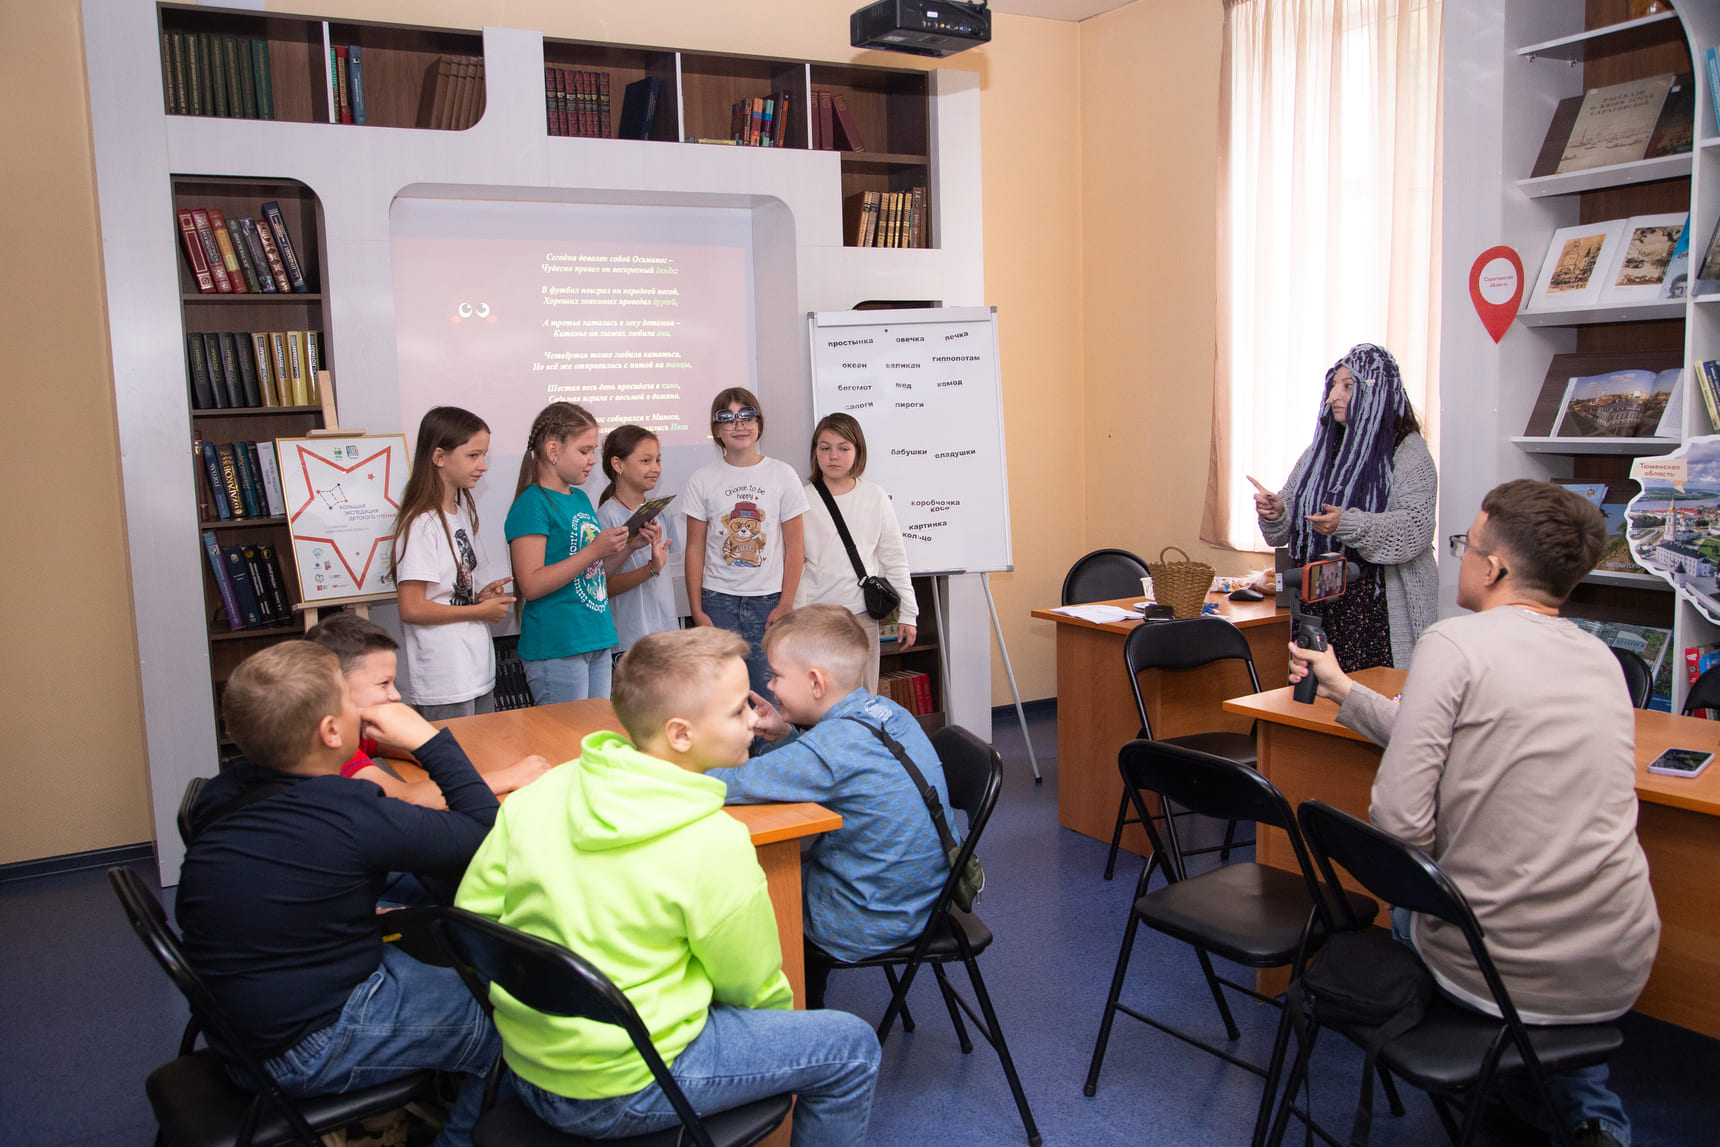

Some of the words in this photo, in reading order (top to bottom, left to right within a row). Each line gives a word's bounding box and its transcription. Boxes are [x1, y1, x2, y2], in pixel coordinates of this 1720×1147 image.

[546, 253, 577, 262] Сегодня
[578, 254, 608, 263] доволен
[609, 255, 631, 263] собой
[632, 256, 668, 265] Осьминог
[542, 264, 573, 273] Чудесно
[612, 266, 654, 275] воскресный
[541, 286, 548, 294] В
[548, 286, 579, 296] футбол
[581, 287, 611, 296] поиграл
[623, 288, 656, 297] передней
[657, 288, 680, 297] ногой,
[543, 297, 579, 306] Хороших
[618, 298, 651, 307] проведал
[542, 319, 549, 327] А
[550, 320, 581, 328] третья
[582, 320, 618, 328] каталась
[624, 320, 641, 329] лесу
[552, 329, 588, 338] Катанье
[599, 330, 626, 338] лыжах
[627, 329, 655, 337] любила
[828, 337, 874, 348] простынка
[895, 336, 925, 344] овечка
[944, 330, 969, 342] печка
[544, 351, 589, 361] Четвёртая
[614, 350, 642, 359] любила
[643, 351, 682, 360] кататься,
[533, 362, 545, 371] Но
[573, 362, 622, 371] отправилась
[629, 360, 654, 369] пятой
[842, 361, 867, 369] океан
[885, 361, 921, 369] великан
[932, 354, 981, 363] гиппопотам
[547, 384, 580, 393] Шестая
[598, 383, 616, 392] день
[617, 382, 655, 392] просидела
[837, 384, 873, 392] бегемот
[895, 381, 912, 389] мед
[937, 379, 963, 388] комод
[582, 394, 608, 403] играла
[615, 392, 645, 401] восьмой
[844, 400, 874, 410] сапоги
[895, 401, 925, 409] пироги
[607, 415, 644, 424] собирался
[890, 448, 928, 457] бабушки
[934, 449, 977, 460] оладушки
[1639, 462, 1681, 471] Тюменская
[209, 462, 221, 487] ГОГОЛЬ
[1644, 470, 1675, 478] область
[223, 465, 240, 509] БУЛГАКОВ
[725, 485, 747, 496] Choose
[757, 487, 766, 496] be
[736, 493, 754, 501] happy
[909, 520, 948, 531] картинка
